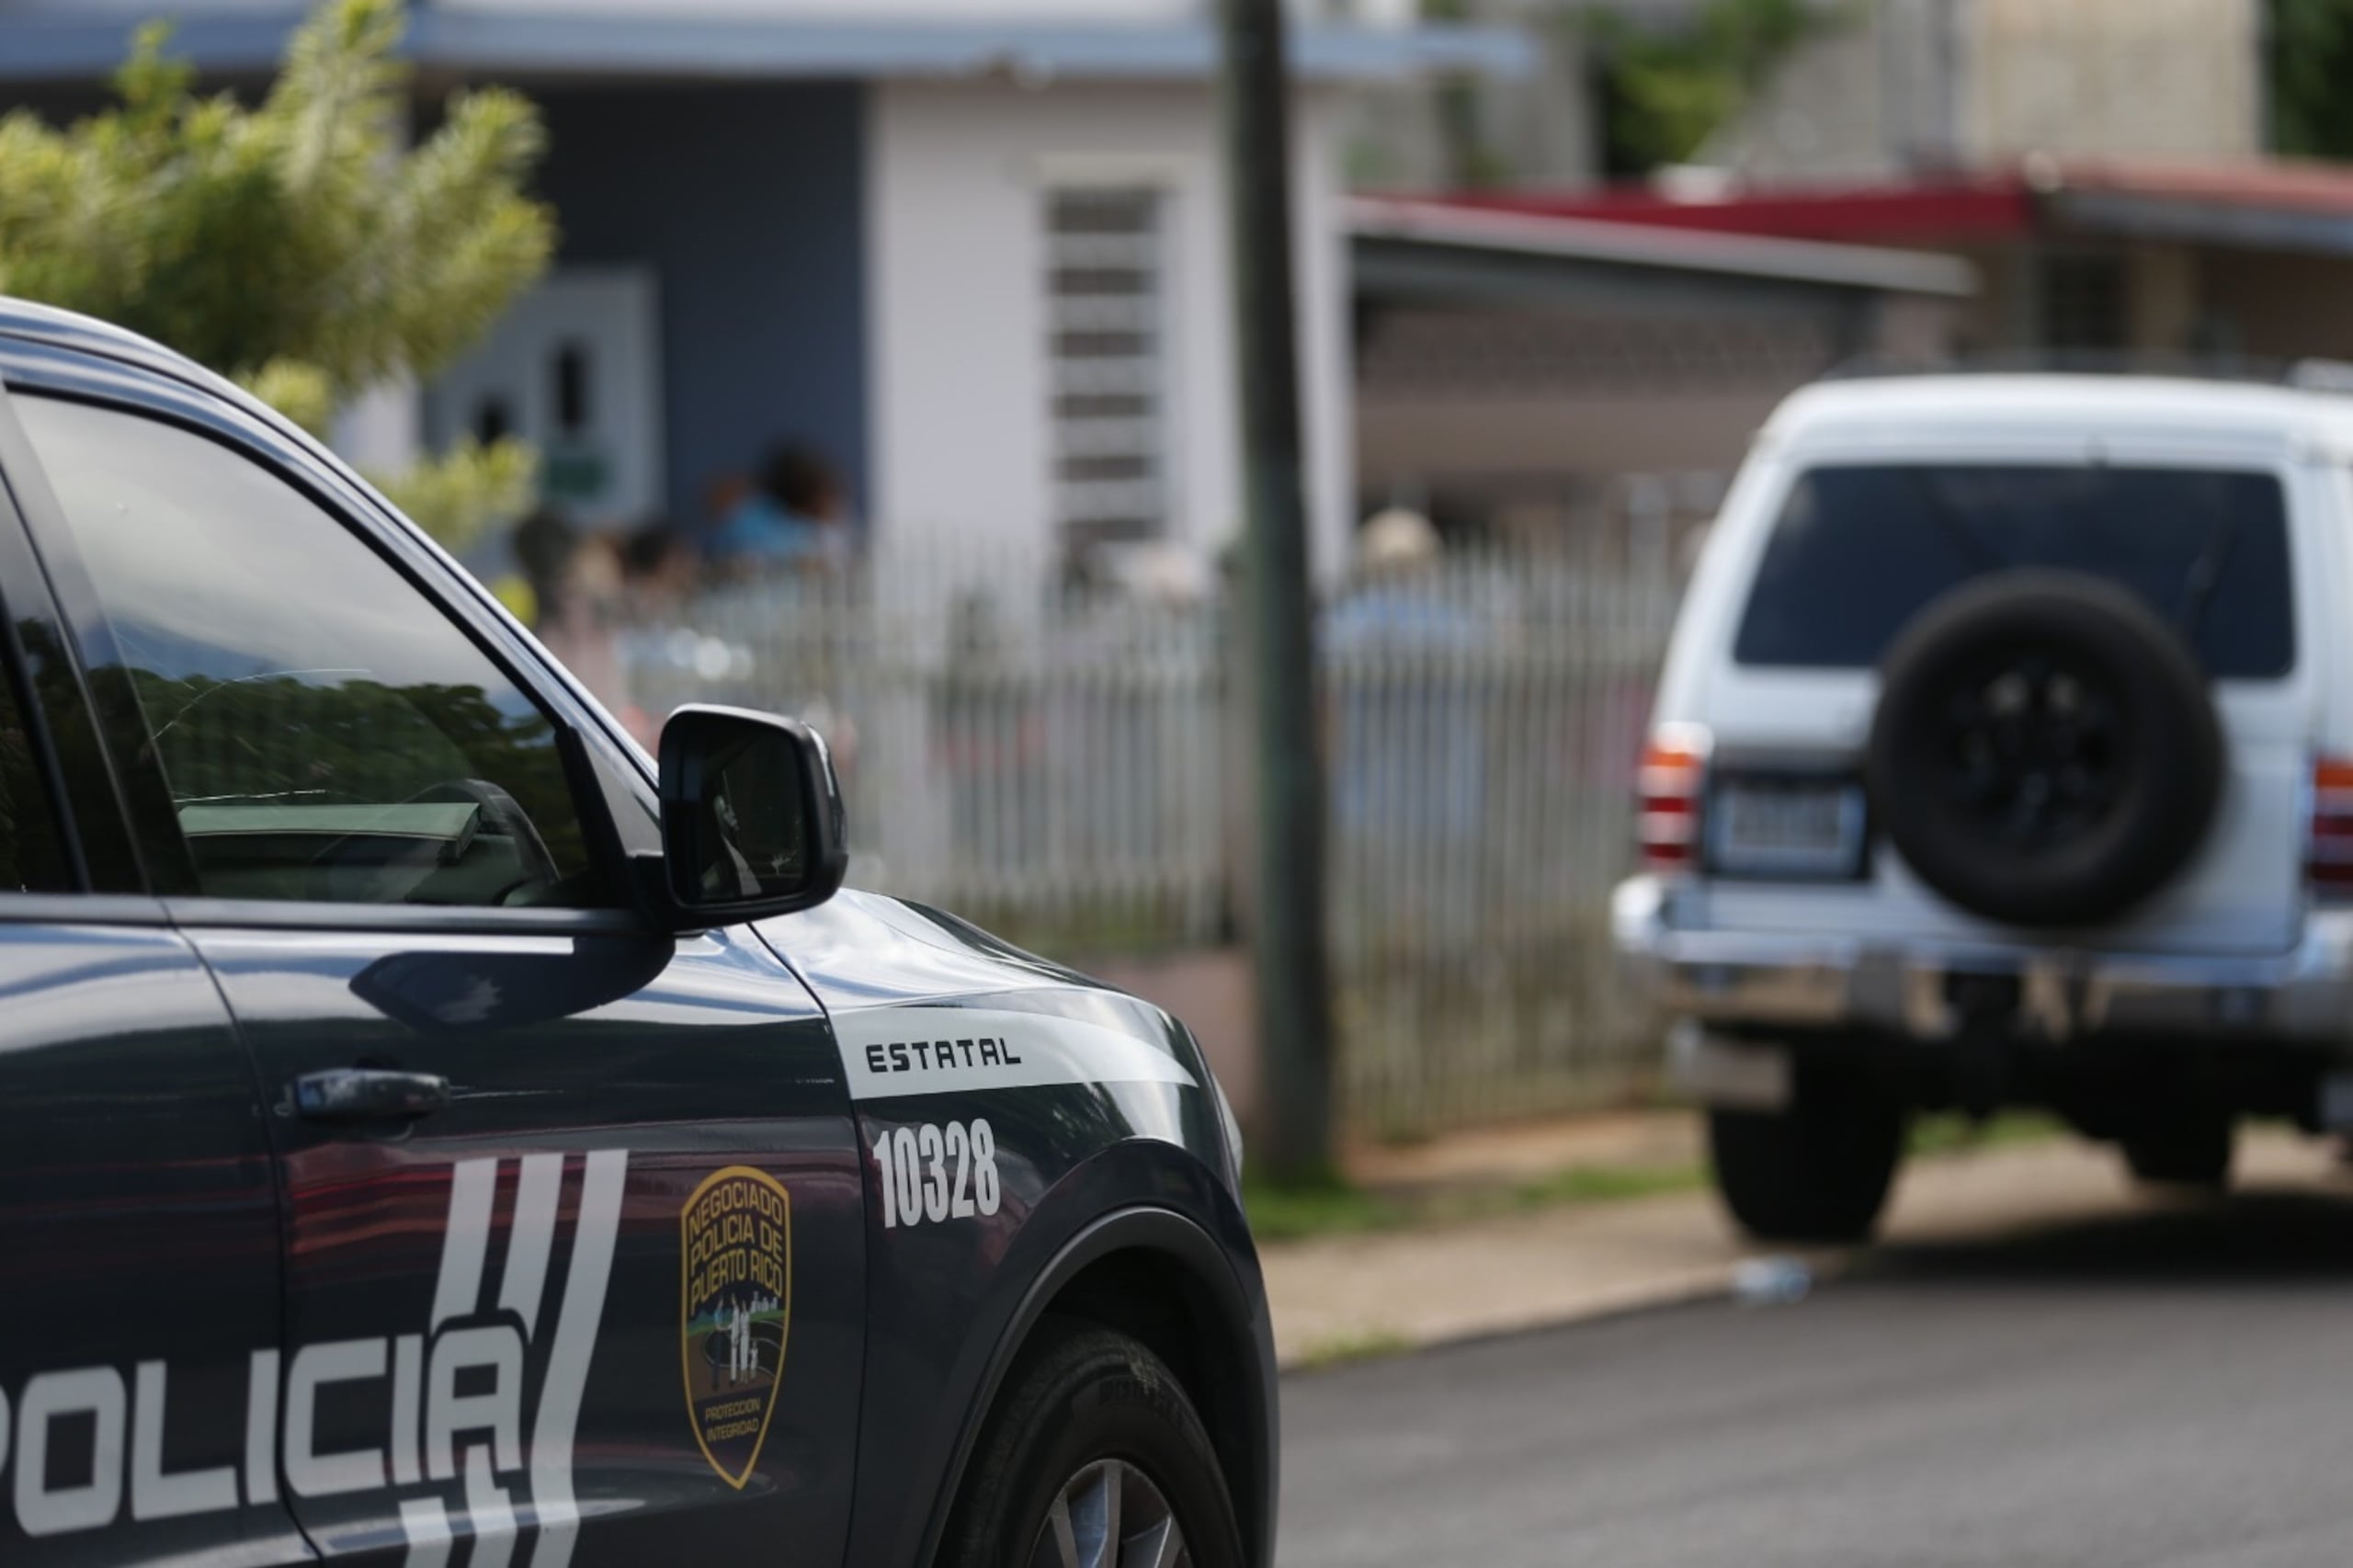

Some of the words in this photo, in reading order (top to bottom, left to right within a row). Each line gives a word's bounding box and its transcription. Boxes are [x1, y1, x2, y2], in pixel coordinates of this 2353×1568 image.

[866, 1038, 1022, 1073] ESTATAL
[873, 1118, 1001, 1229] 10328
[689, 1182, 783, 1242] NEGOCIADO
[690, 1213, 755, 1276] POLICIA
[760, 1221, 783, 1263] DE
[690, 1248, 746, 1316] PUERTO
[750, 1250, 783, 1299] RICO
[0, 1324, 522, 1538] OLICIA
